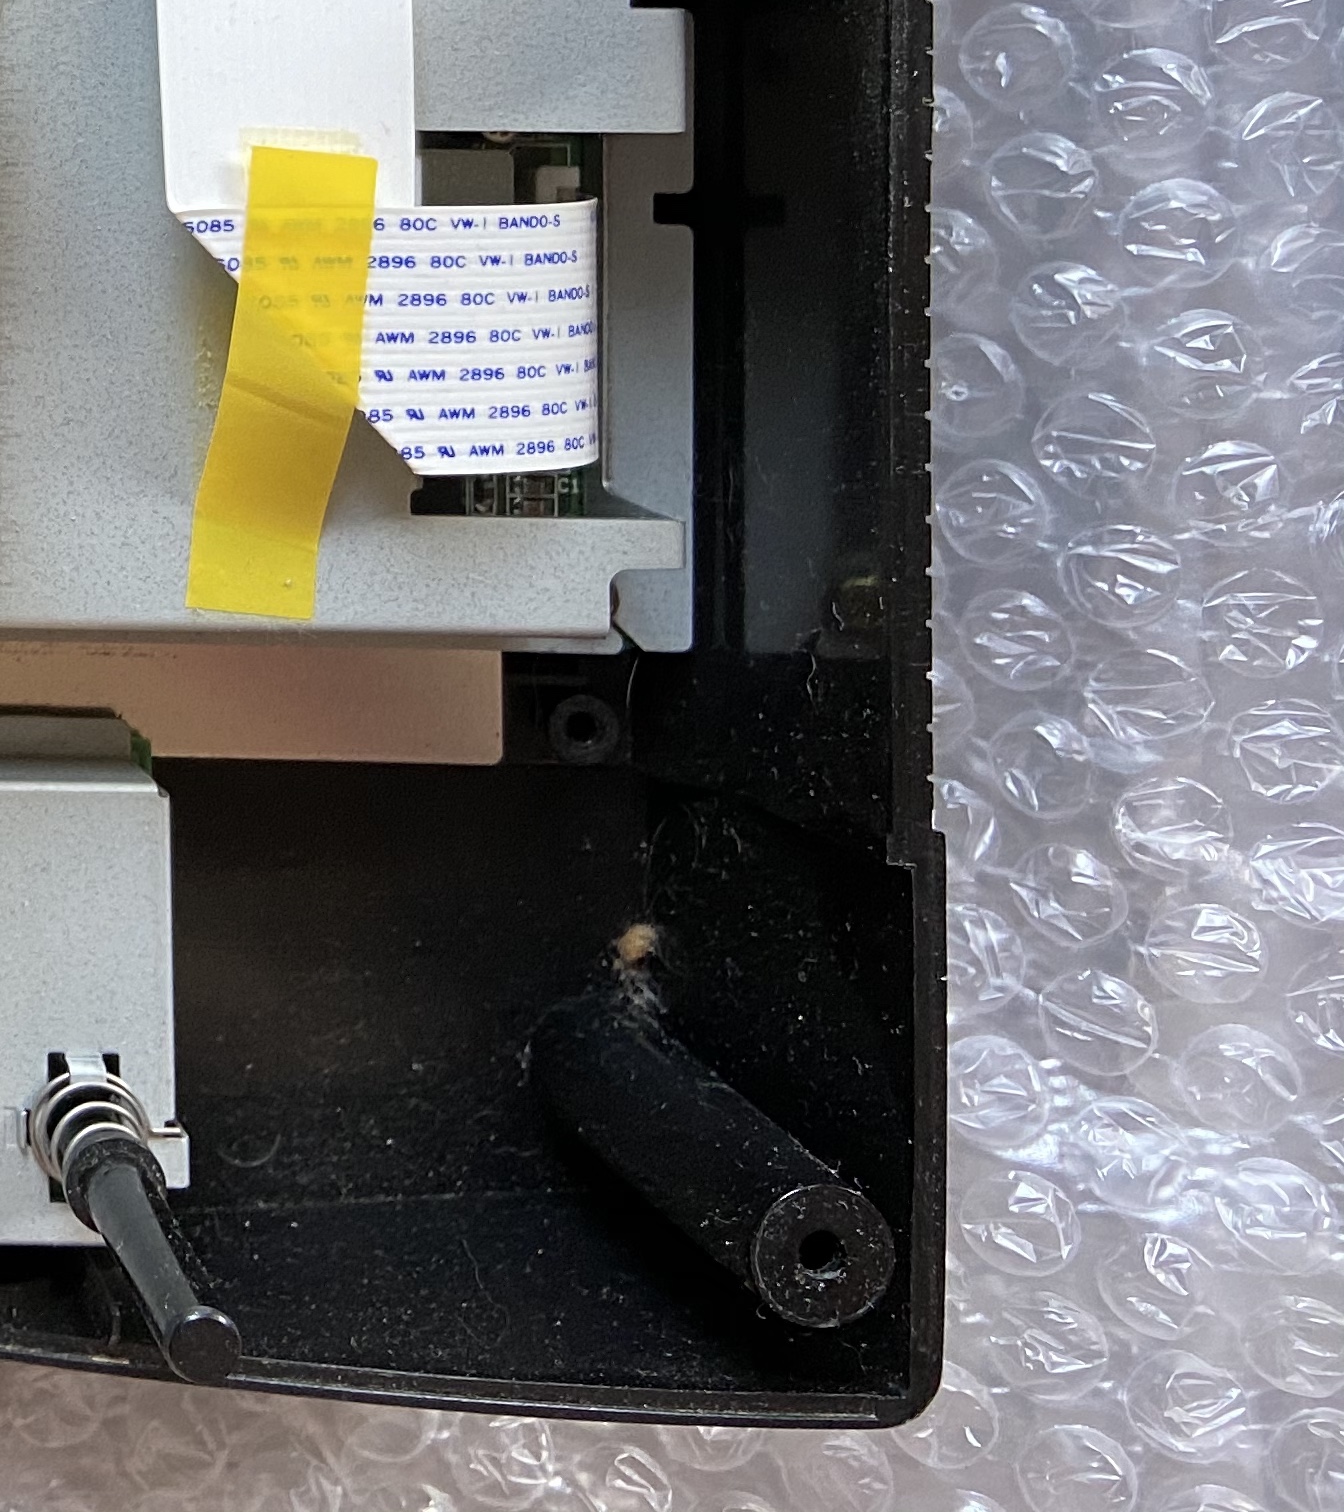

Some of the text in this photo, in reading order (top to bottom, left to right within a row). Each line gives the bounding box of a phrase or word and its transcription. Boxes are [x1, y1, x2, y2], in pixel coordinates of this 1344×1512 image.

[400, 217, 437, 232] 80C
[499, 215, 561, 229] BANDO-S
[367, 255, 416, 270] 2896
[430, 254, 466, 269] 80C
[524, 249, 578, 265] BANDO-S
[397, 293, 447, 307] 2896
[460, 292, 495, 306] 80C
[548, 285, 590, 302] BANDO-S
[375, 329, 522, 345] AWM 2896 80C
[408, 365, 547, 382] AWM 2896 80C
[438, 401, 568, 421] AWM 2896 80C
[469, 444, 505, 457] AWM
[516, 441, 555, 456] 2896
